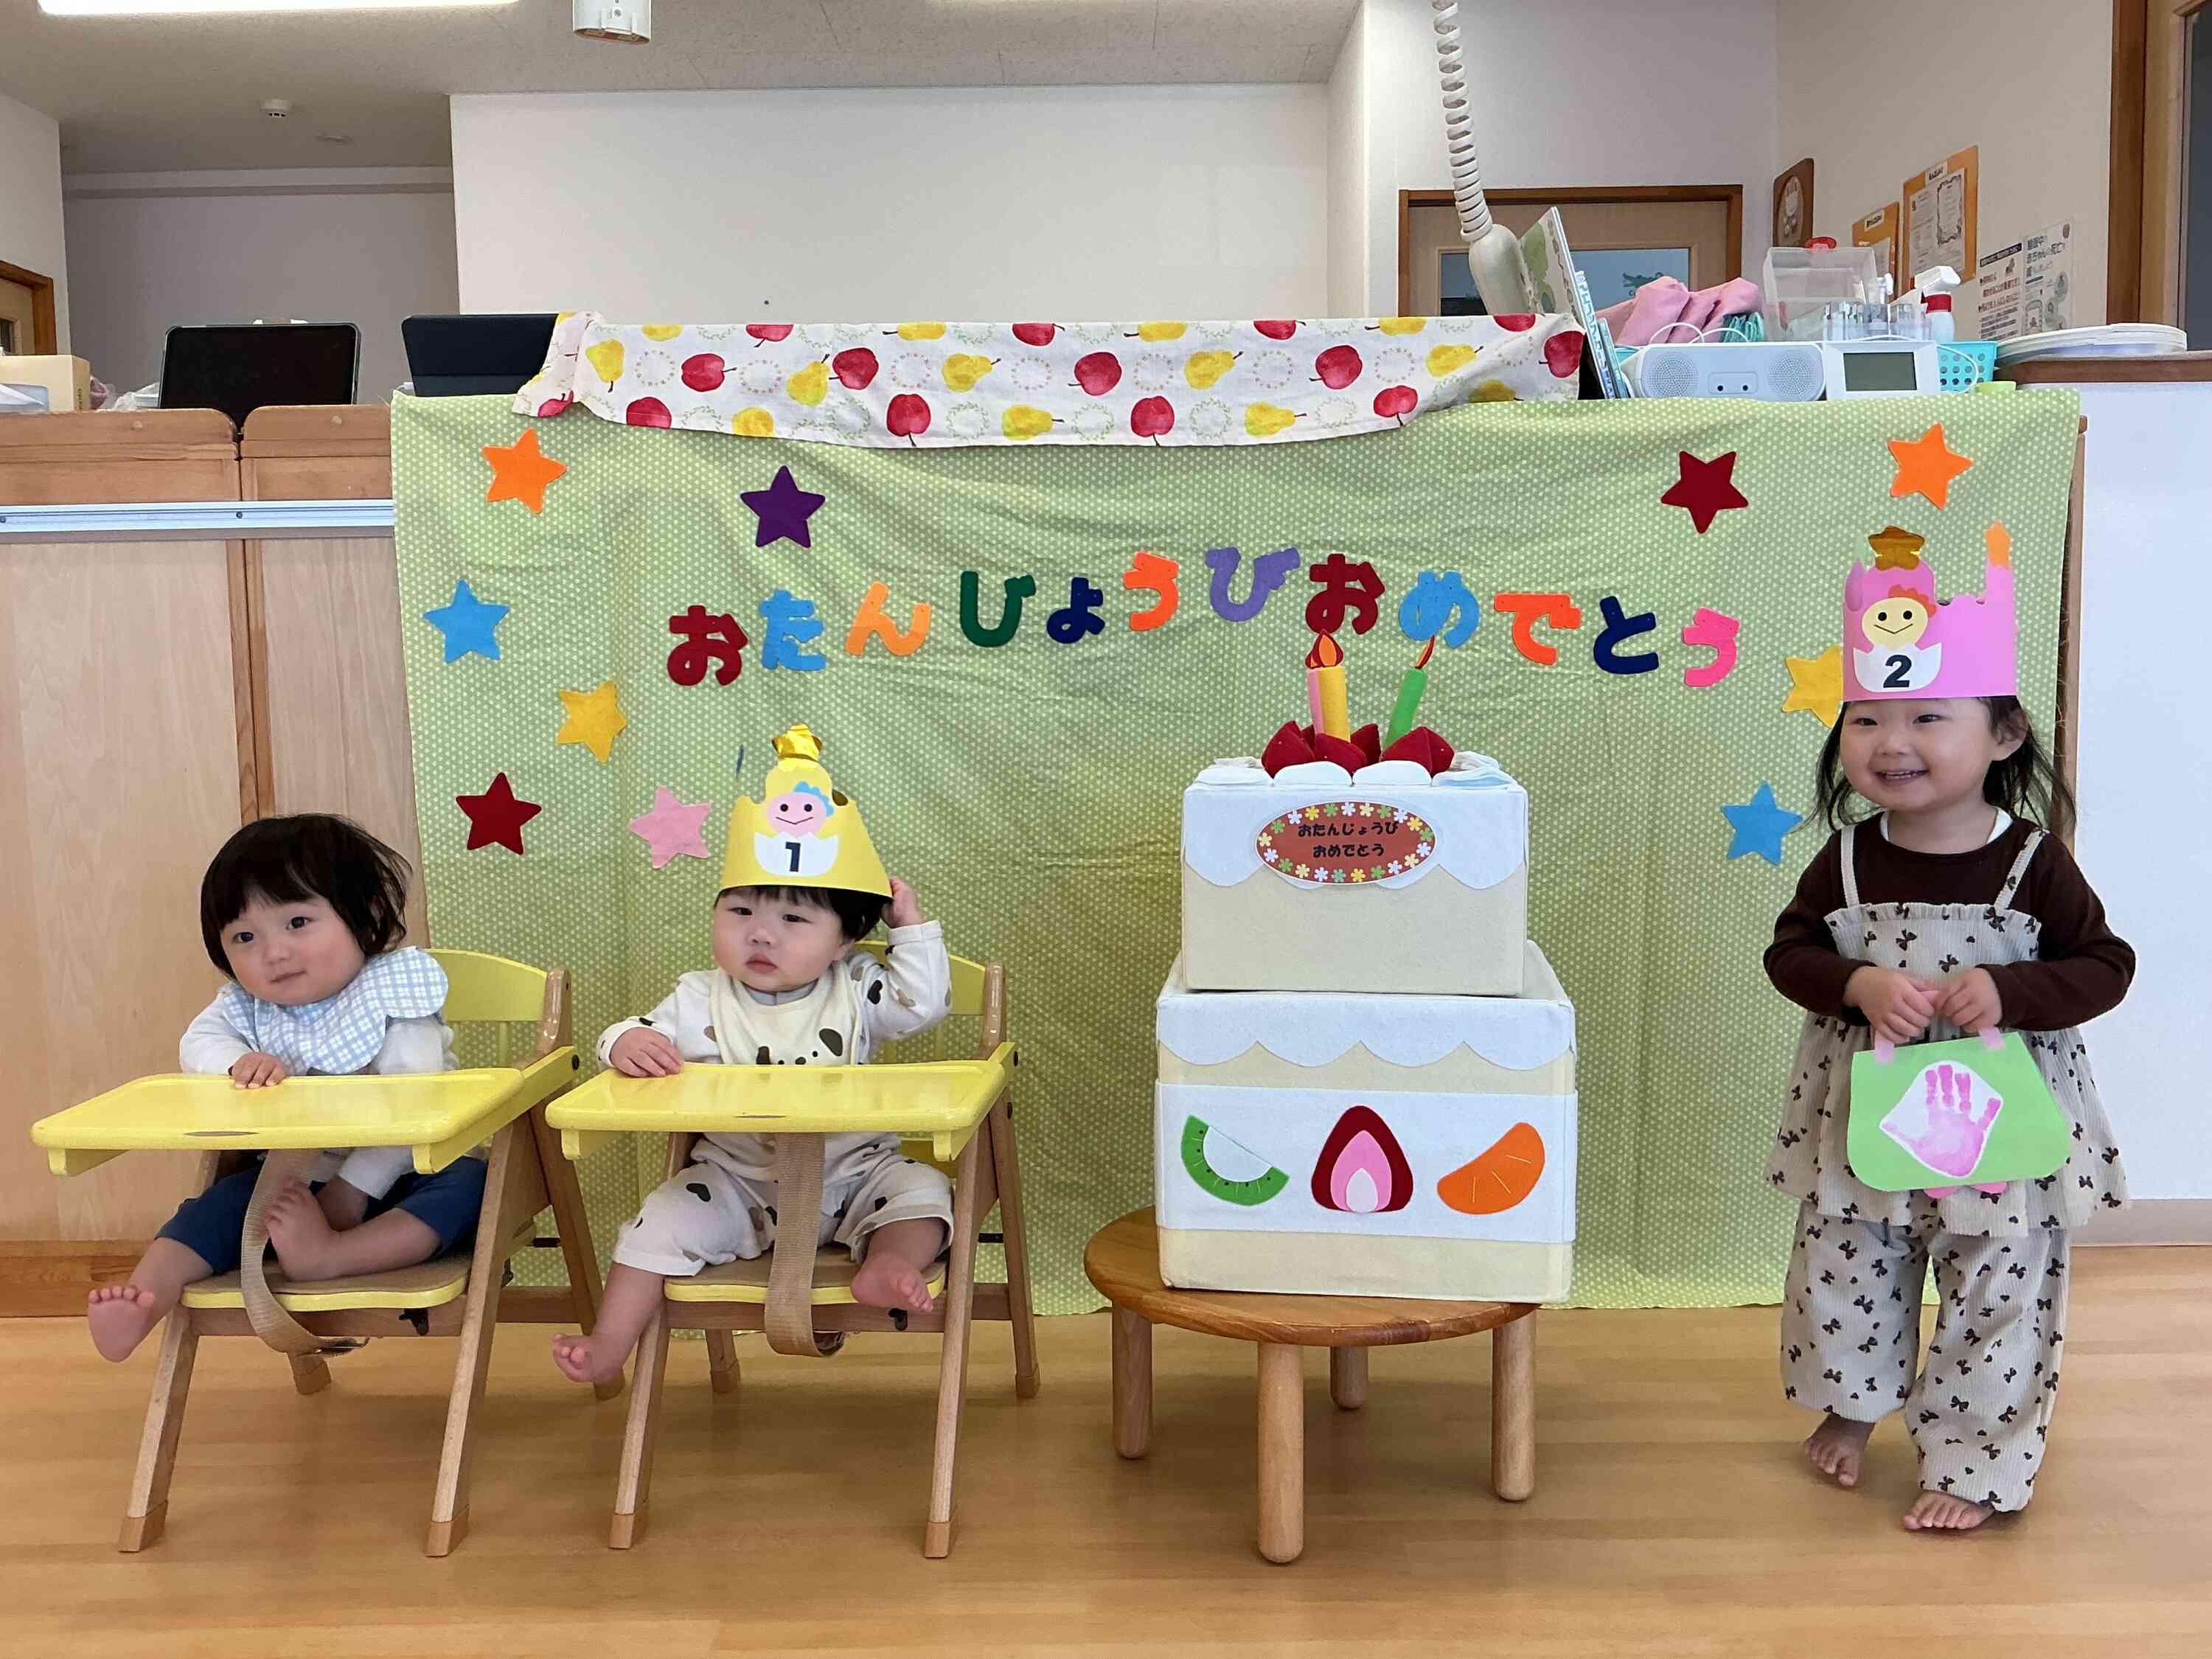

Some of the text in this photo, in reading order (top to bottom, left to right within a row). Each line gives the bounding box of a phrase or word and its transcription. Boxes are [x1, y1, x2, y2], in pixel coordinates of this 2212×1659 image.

[667, 547, 1740, 687] おたんじょうびおめでとう
[1883, 654, 1912, 688] 2
[1298, 821, 1399, 838] おたんじょうび
[785, 841, 801, 872] 1
[1312, 844, 1385, 858] おめでとう
